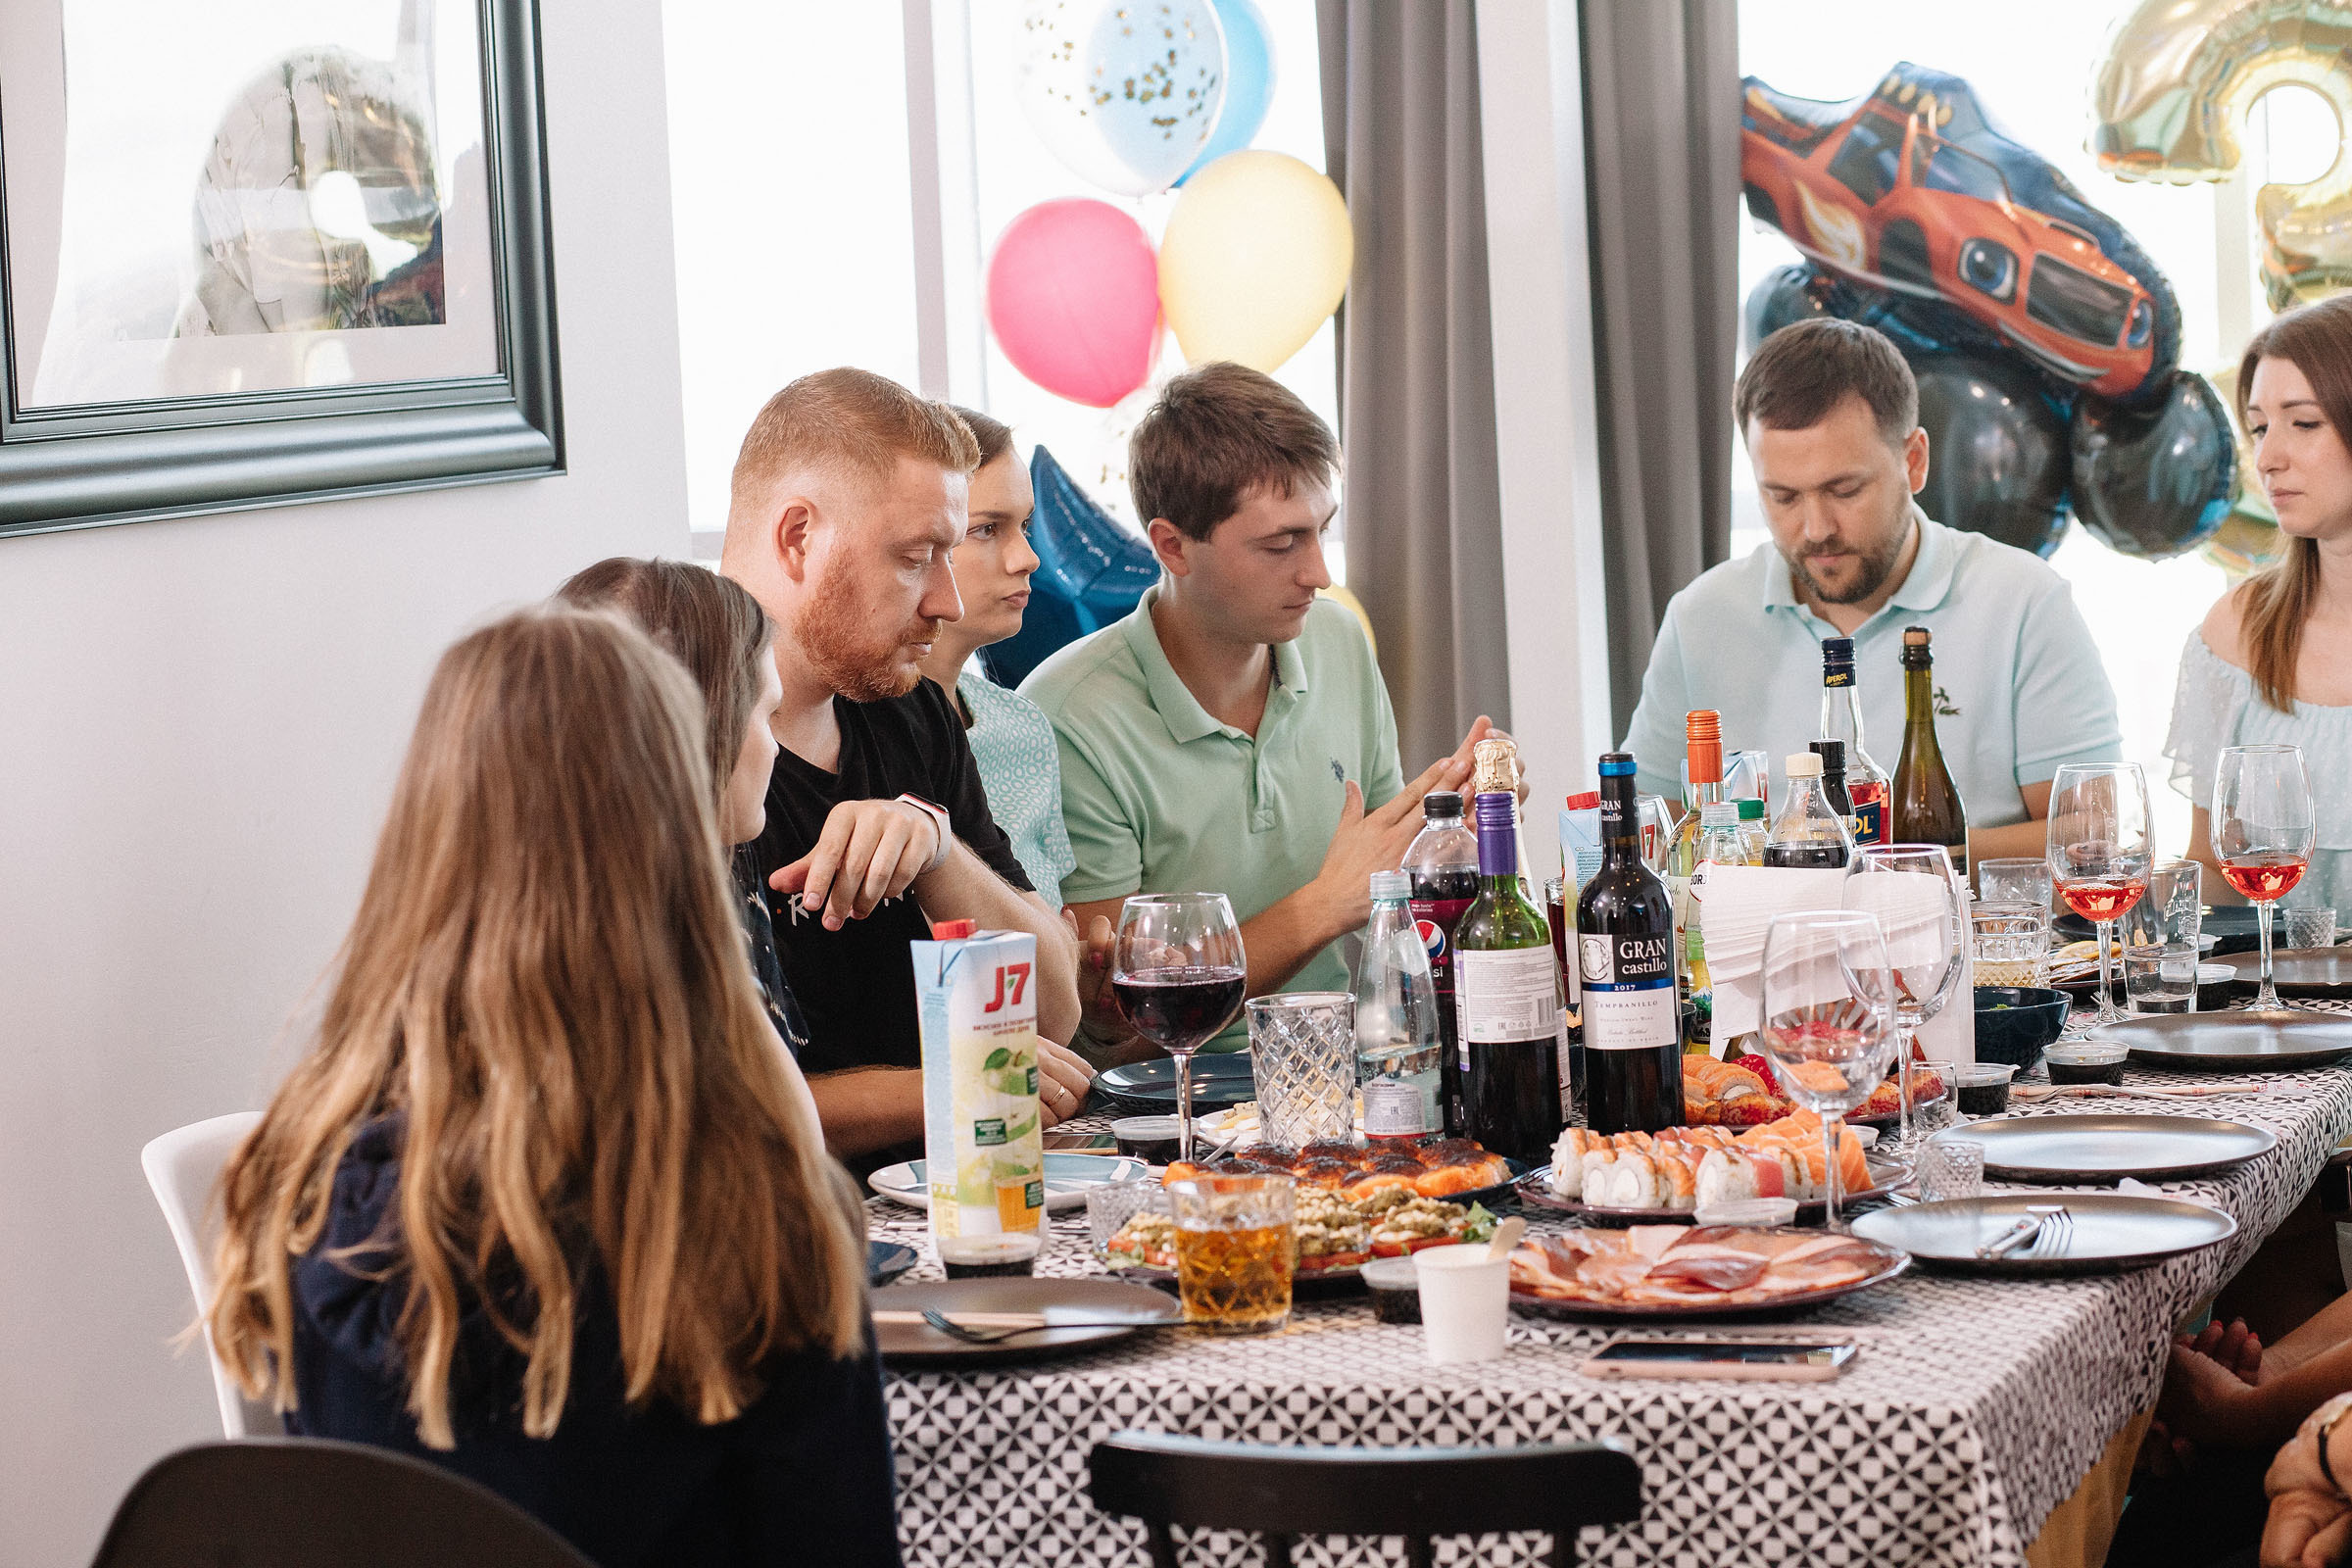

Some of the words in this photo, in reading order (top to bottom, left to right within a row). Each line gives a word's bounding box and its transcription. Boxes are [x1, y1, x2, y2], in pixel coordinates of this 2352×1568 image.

[1826, 672, 1848, 684] APEROL
[1620, 939, 1667, 959] GRAN
[1622, 958, 1668, 975] castillo
[984, 962, 1031, 1013] J7
[1594, 1000, 1659, 1009] TEMPRANILLO
